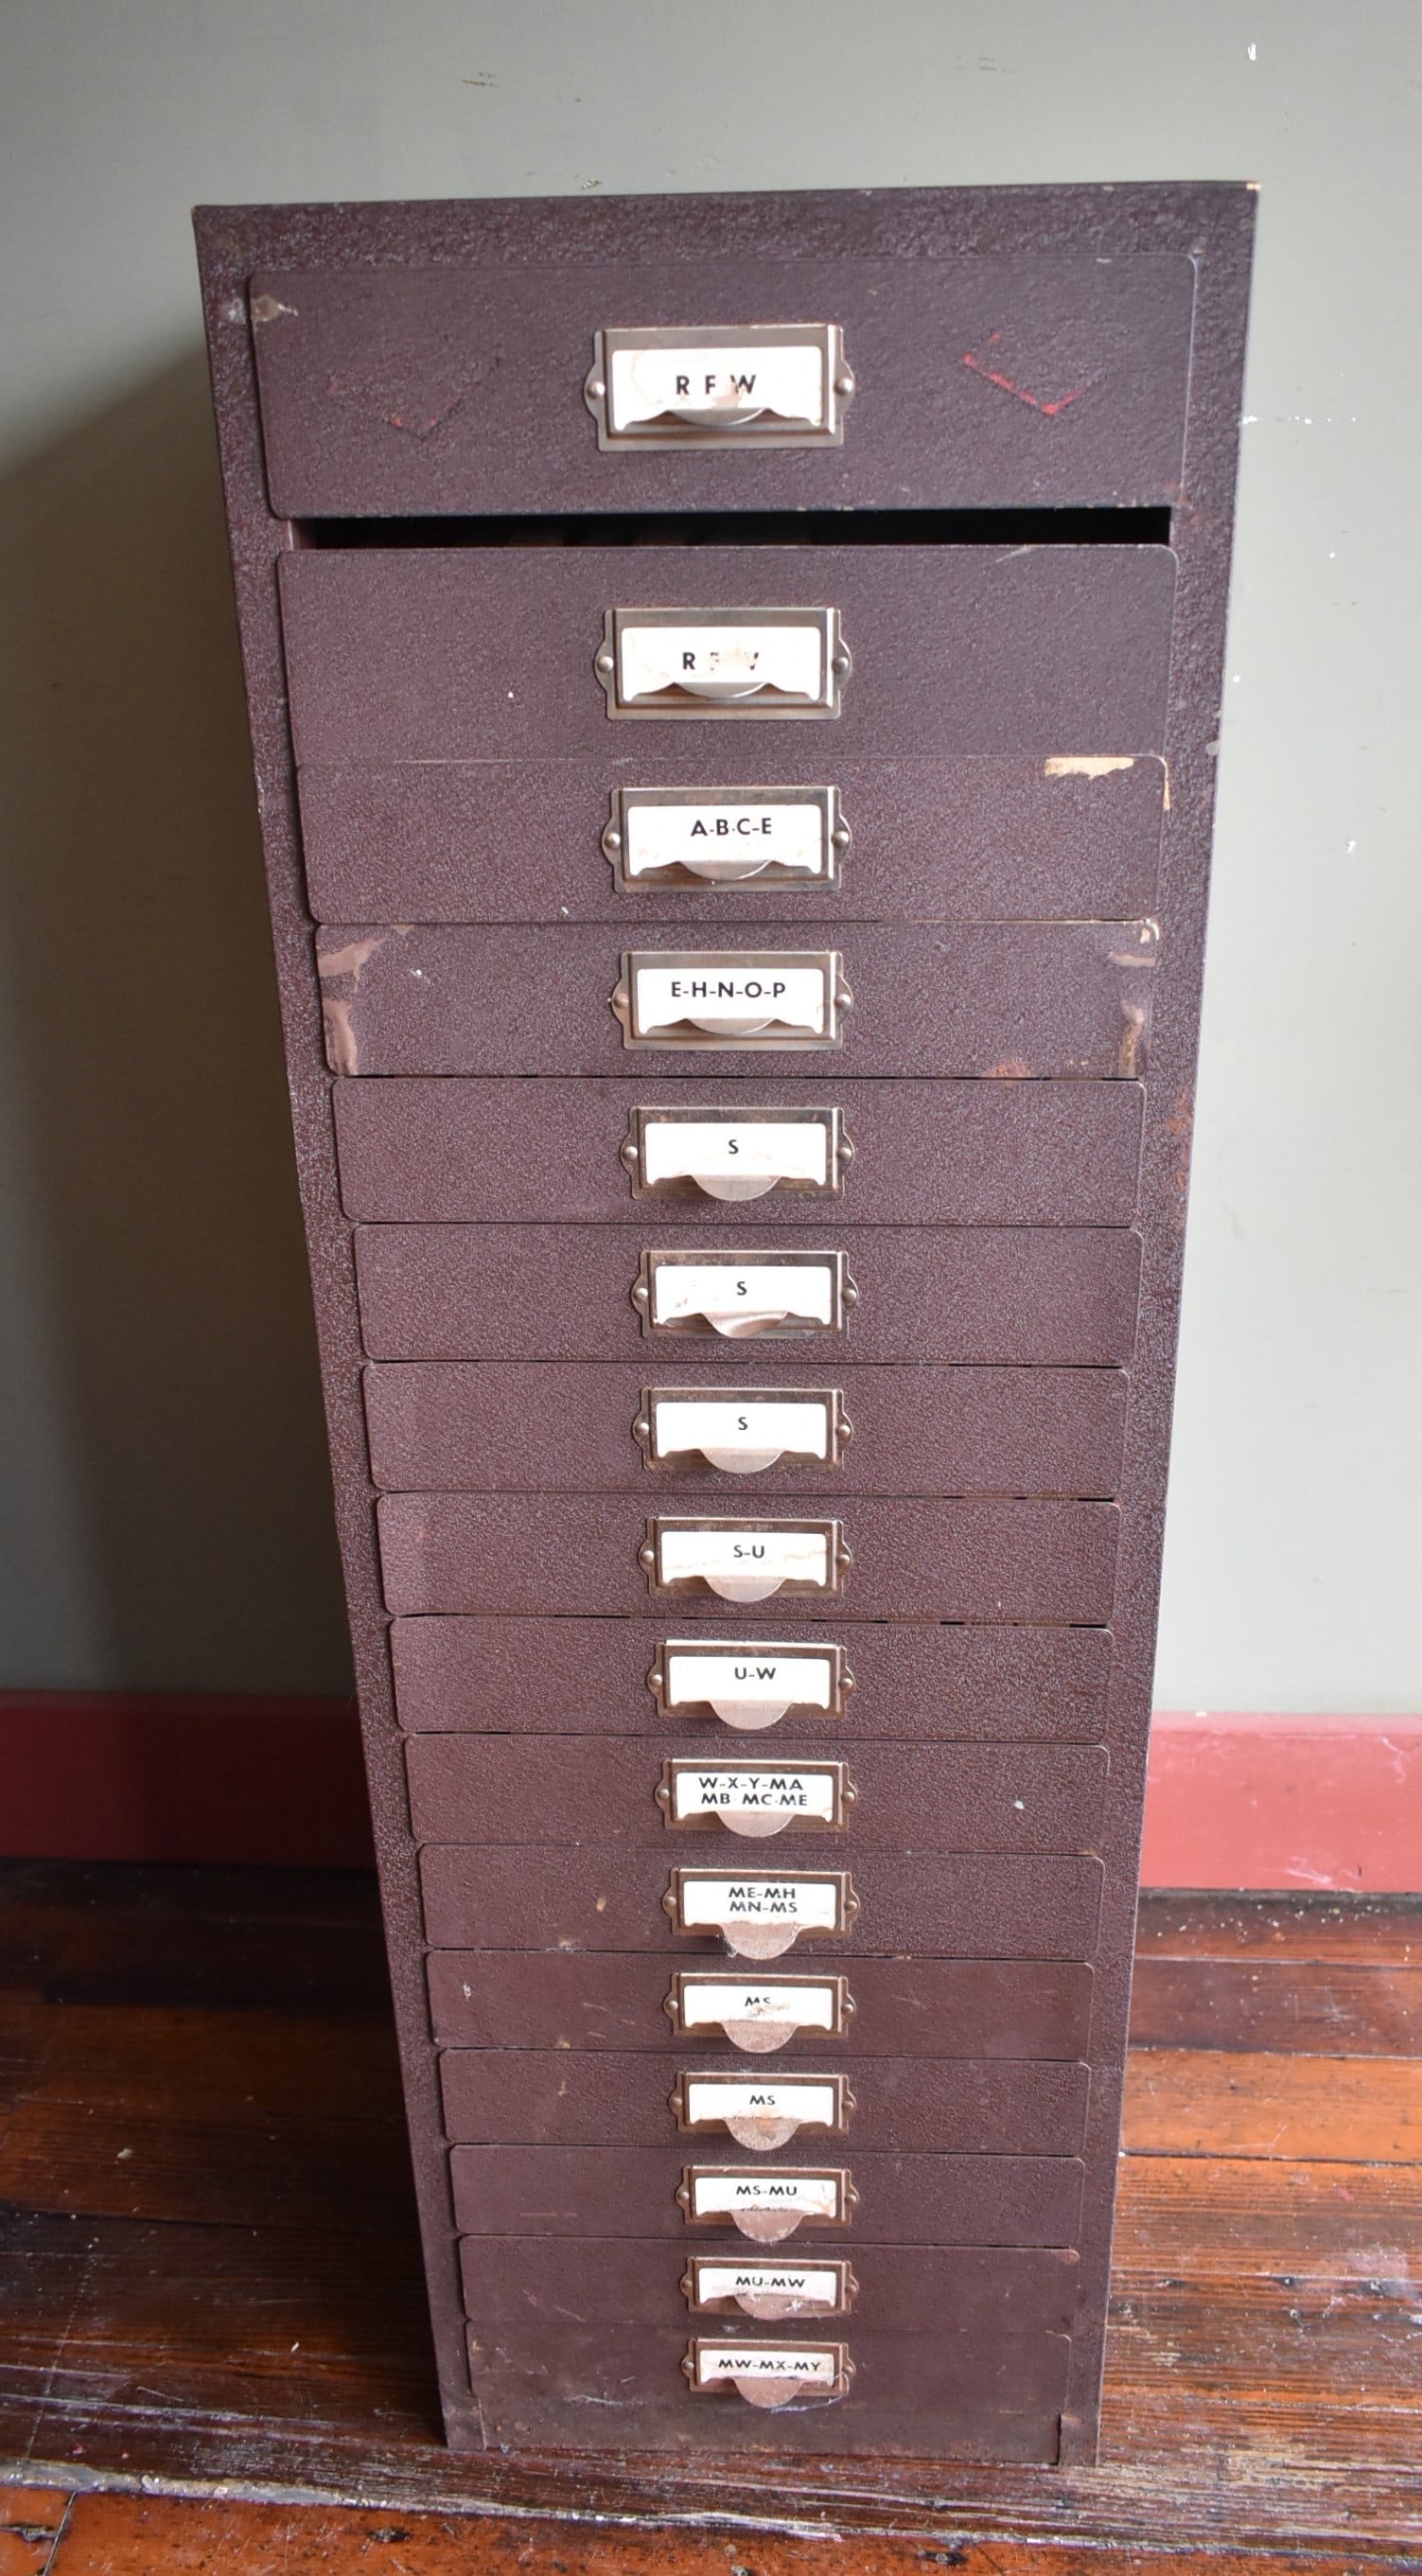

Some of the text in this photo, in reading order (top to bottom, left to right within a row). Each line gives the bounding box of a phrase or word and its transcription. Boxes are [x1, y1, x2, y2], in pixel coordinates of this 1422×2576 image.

[676, 375, 691, 395] R
[704, 375, 716, 395] F
[671, 981, 786, 998] E-H-N-O-P
[728, 1138, 739, 1155] S
[736, 1280, 747, 1297] S
[737, 1416, 748, 1431] S
[733, 1544, 765, 1559] S-U
[734, 1667, 777, 1680] U-W
[698, 1776, 803, 1791] W-X-Y-MA
[728, 1887, 796, 1899] ME-MH
[729, 1900, 798, 1914] MN-MS
[749, 2094, 776, 2106] MS
[736, 2185, 798, 2197] MS-MU
[735, 2276, 806, 2287] MU-MW
[718, 2358, 821, 2372] MW-MX-MY
